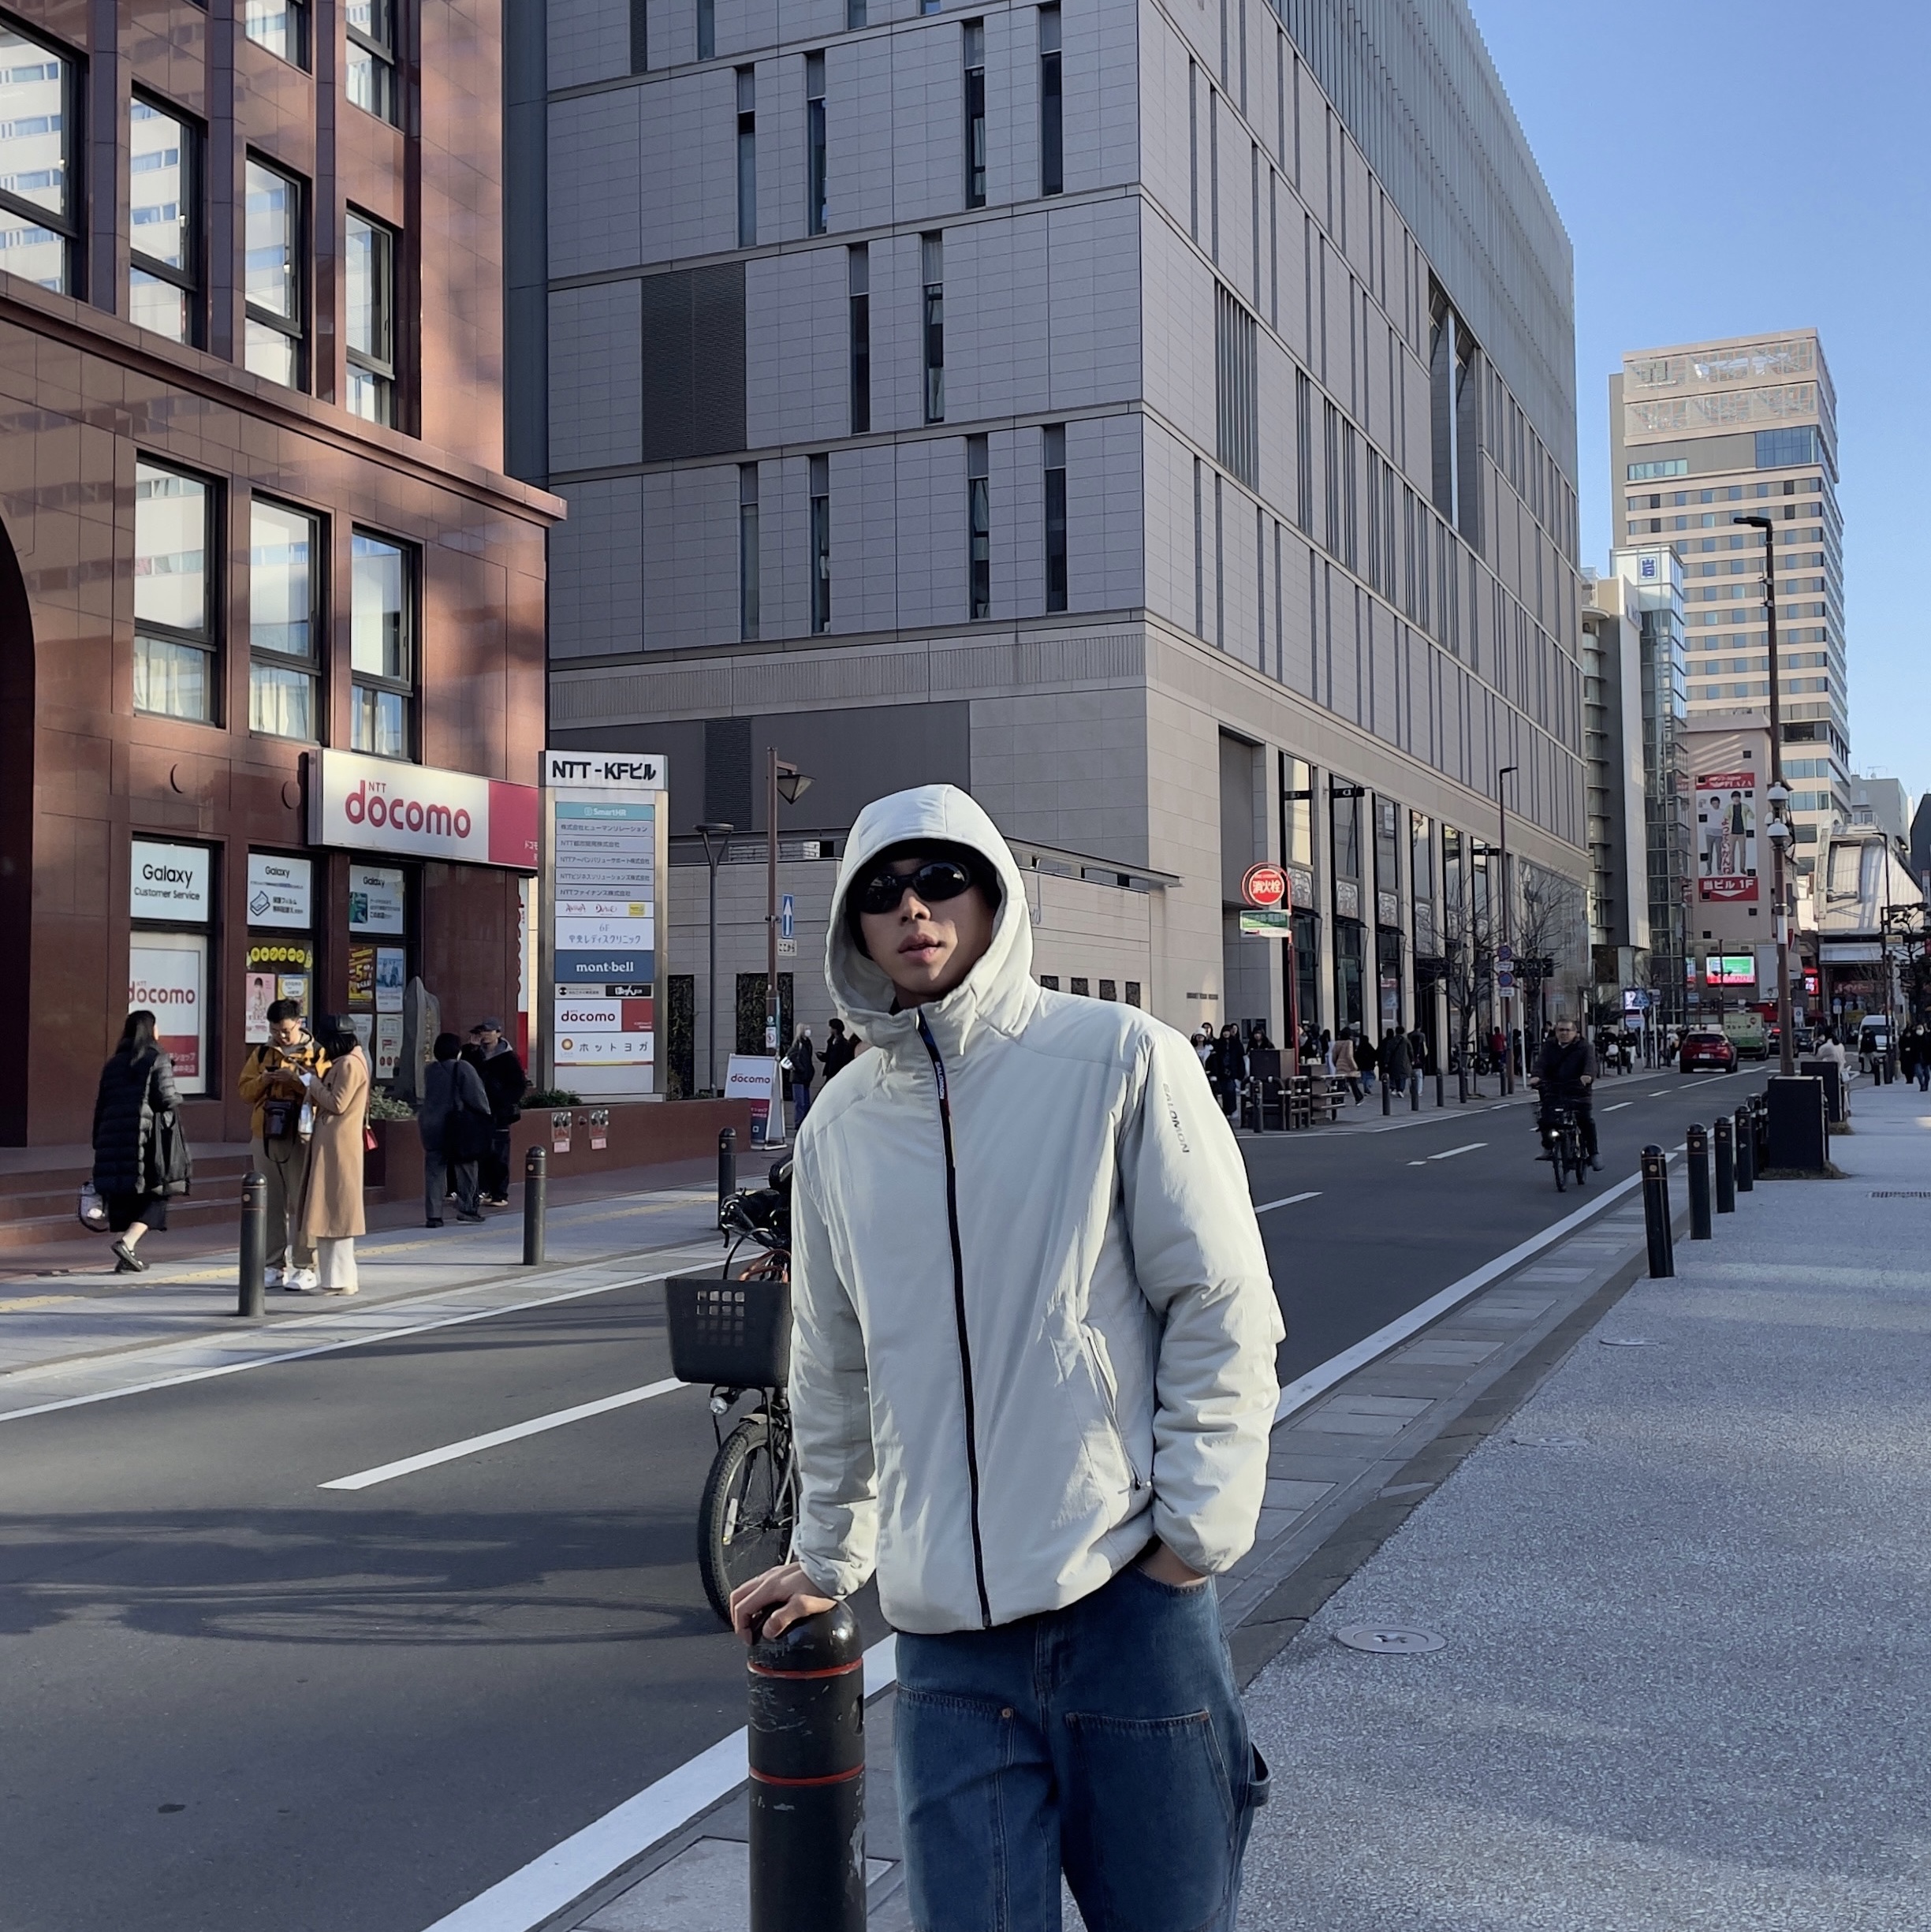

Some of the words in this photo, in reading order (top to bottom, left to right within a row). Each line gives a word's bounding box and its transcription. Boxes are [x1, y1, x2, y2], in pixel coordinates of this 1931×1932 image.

[368, 781, 386, 793] NTT
[345, 780, 471, 838] docomo
[593, 807, 627, 816] SmartHR
[143, 863, 192, 889] Galaxy
[265, 866, 290, 878] Galaxy
[363, 876, 385, 889] Galaxy
[1252, 879, 1281, 893] 消火栓
[1739, 879, 1754, 889] 1F
[134, 886, 171, 898] Customer
[173, 890, 200, 901] Service
[129, 981, 196, 1004] docomo
[561, 1010, 615, 1022] docomo
[579, 1042, 648, 1052] ホットヨガ
[730, 1073, 770, 1084] docomo
